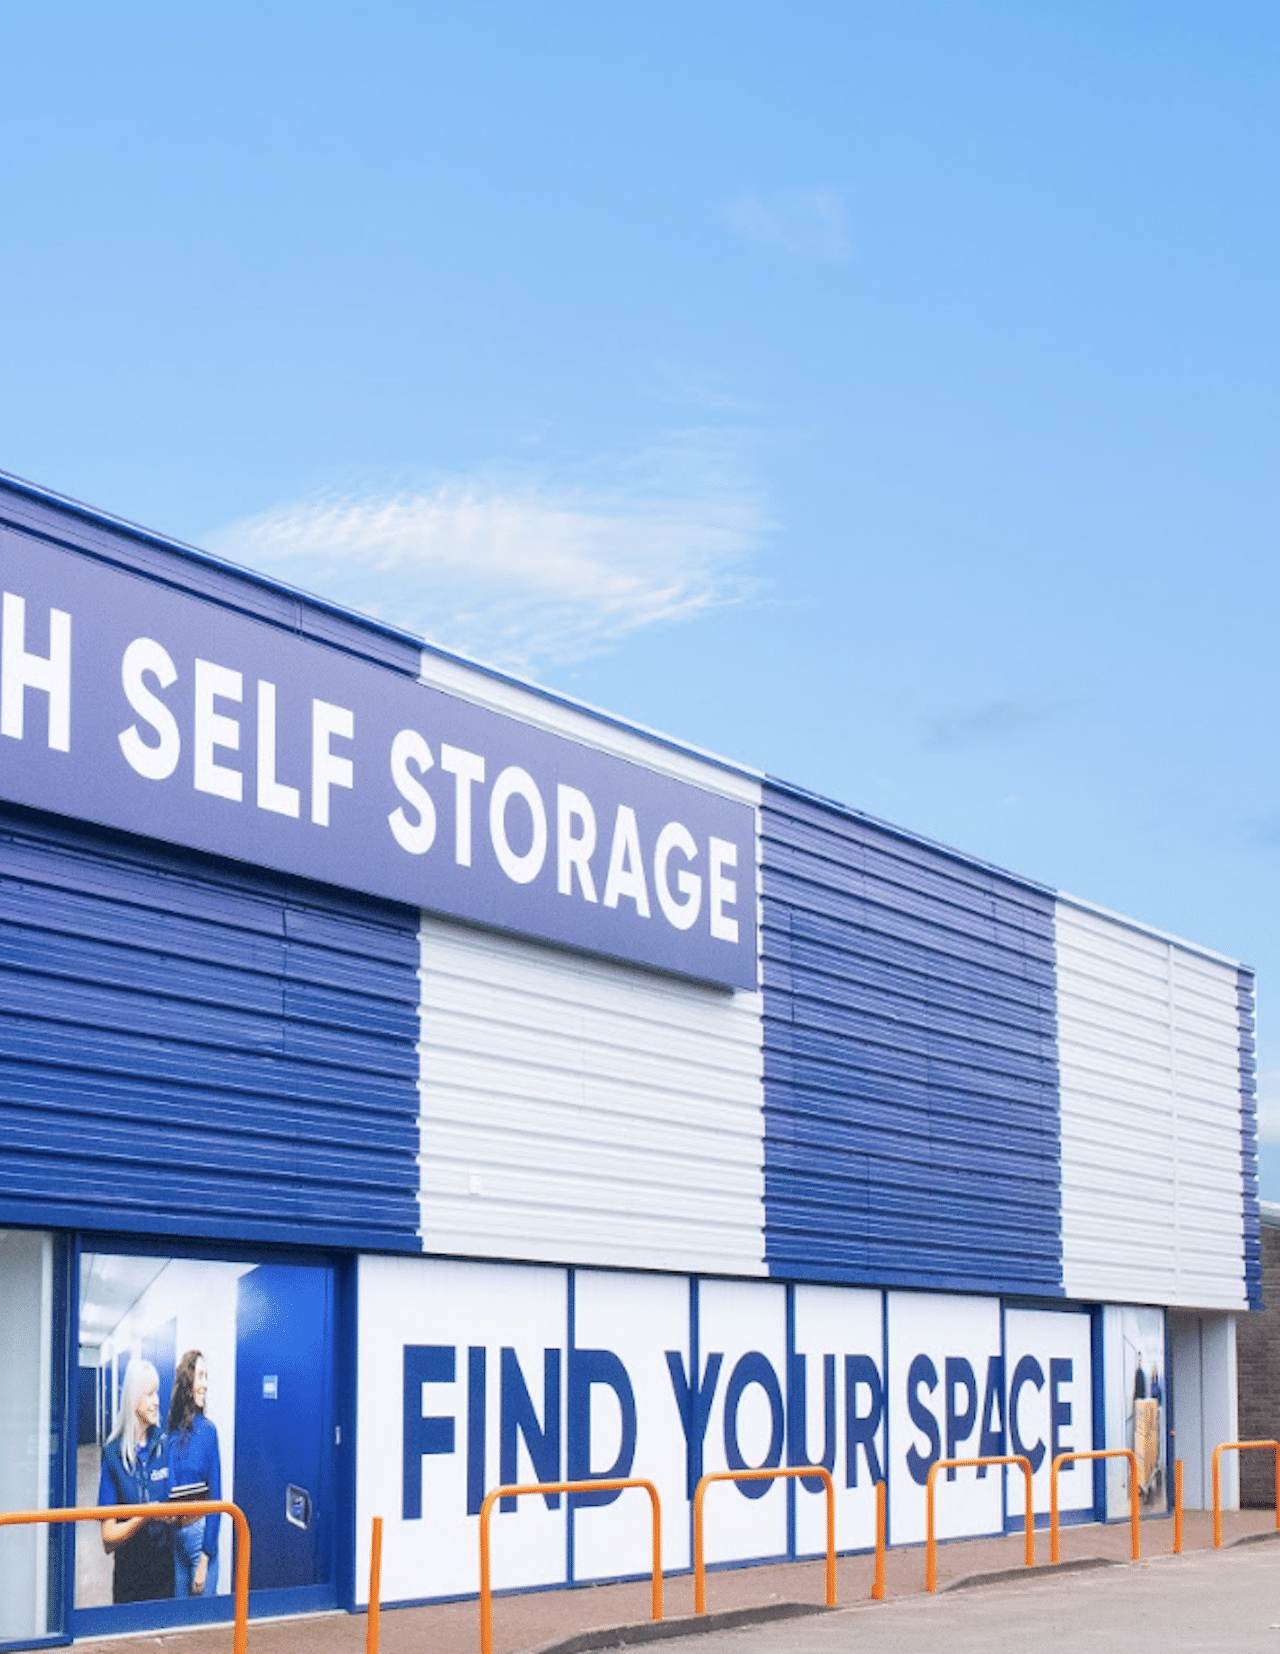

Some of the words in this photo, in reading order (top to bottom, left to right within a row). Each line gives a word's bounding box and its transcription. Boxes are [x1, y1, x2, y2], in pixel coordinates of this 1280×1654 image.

[118, 637, 355, 827] SELF
[388, 729, 739, 943] STORAGE
[402, 1344, 638, 1520] FIND
[664, 1350, 886, 1501] YOUR
[905, 1353, 1074, 1486] SPACE
